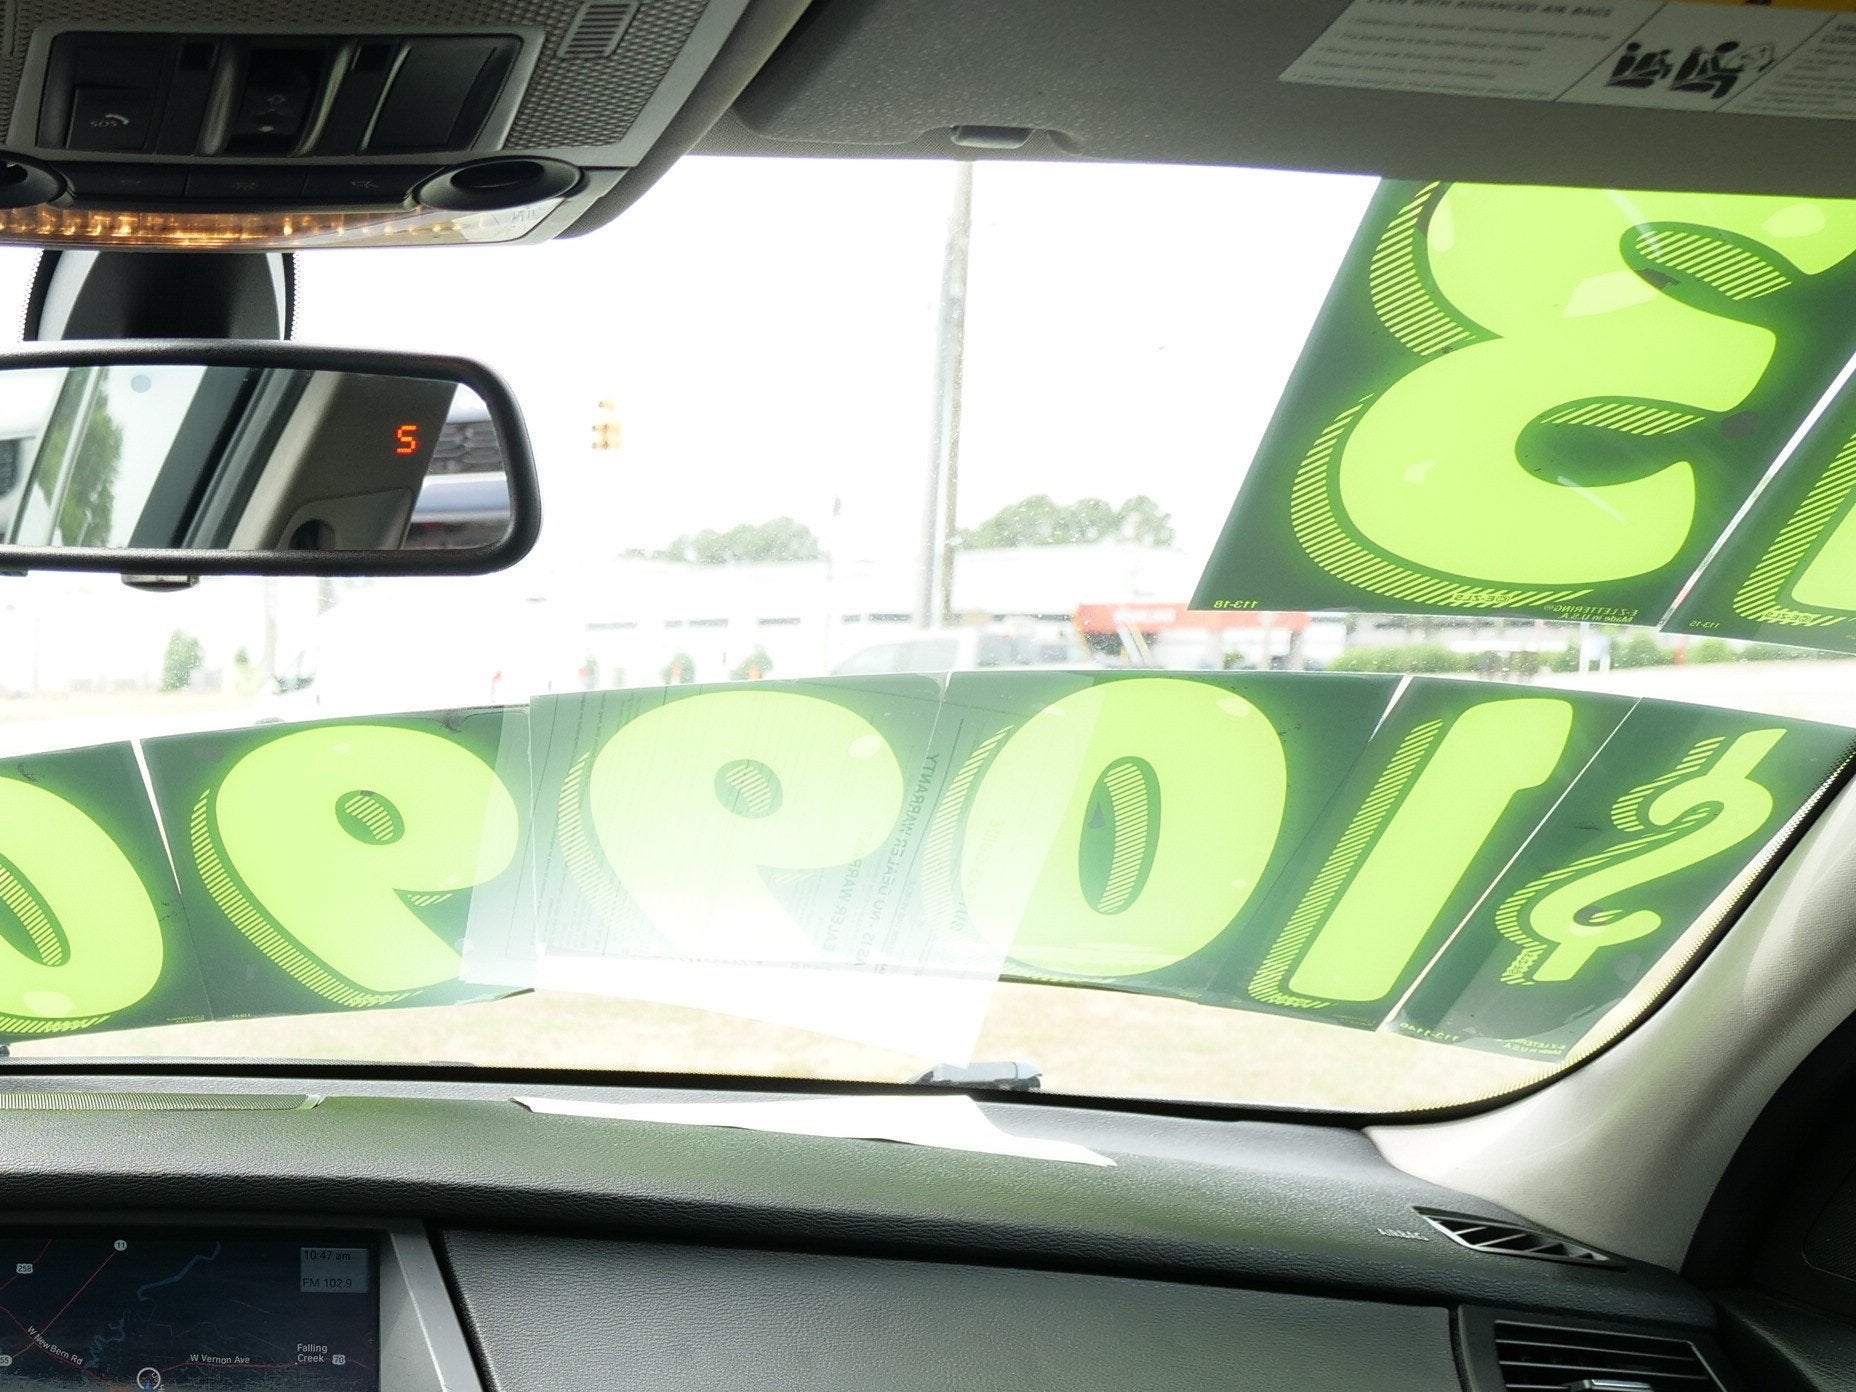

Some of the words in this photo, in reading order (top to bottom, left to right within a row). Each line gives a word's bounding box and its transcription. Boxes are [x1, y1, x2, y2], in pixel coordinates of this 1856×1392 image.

[303, 1251, 332, 1261] 10:47
[335, 1253, 351, 1261] am
[302, 1278, 320, 1288] FM
[324, 1279, 352, 1289] 102.9
[35, 1333, 51, 1350] New
[49, 1344, 71, 1361] Bern
[69, 1353, 84, 1366] Rd
[297, 1344, 328, 1354] Falling
[201, 1355, 232, 1364] Vernon
[234, 1356, 250, 1364] Ave
[297, 1354, 325, 1363] Creek
